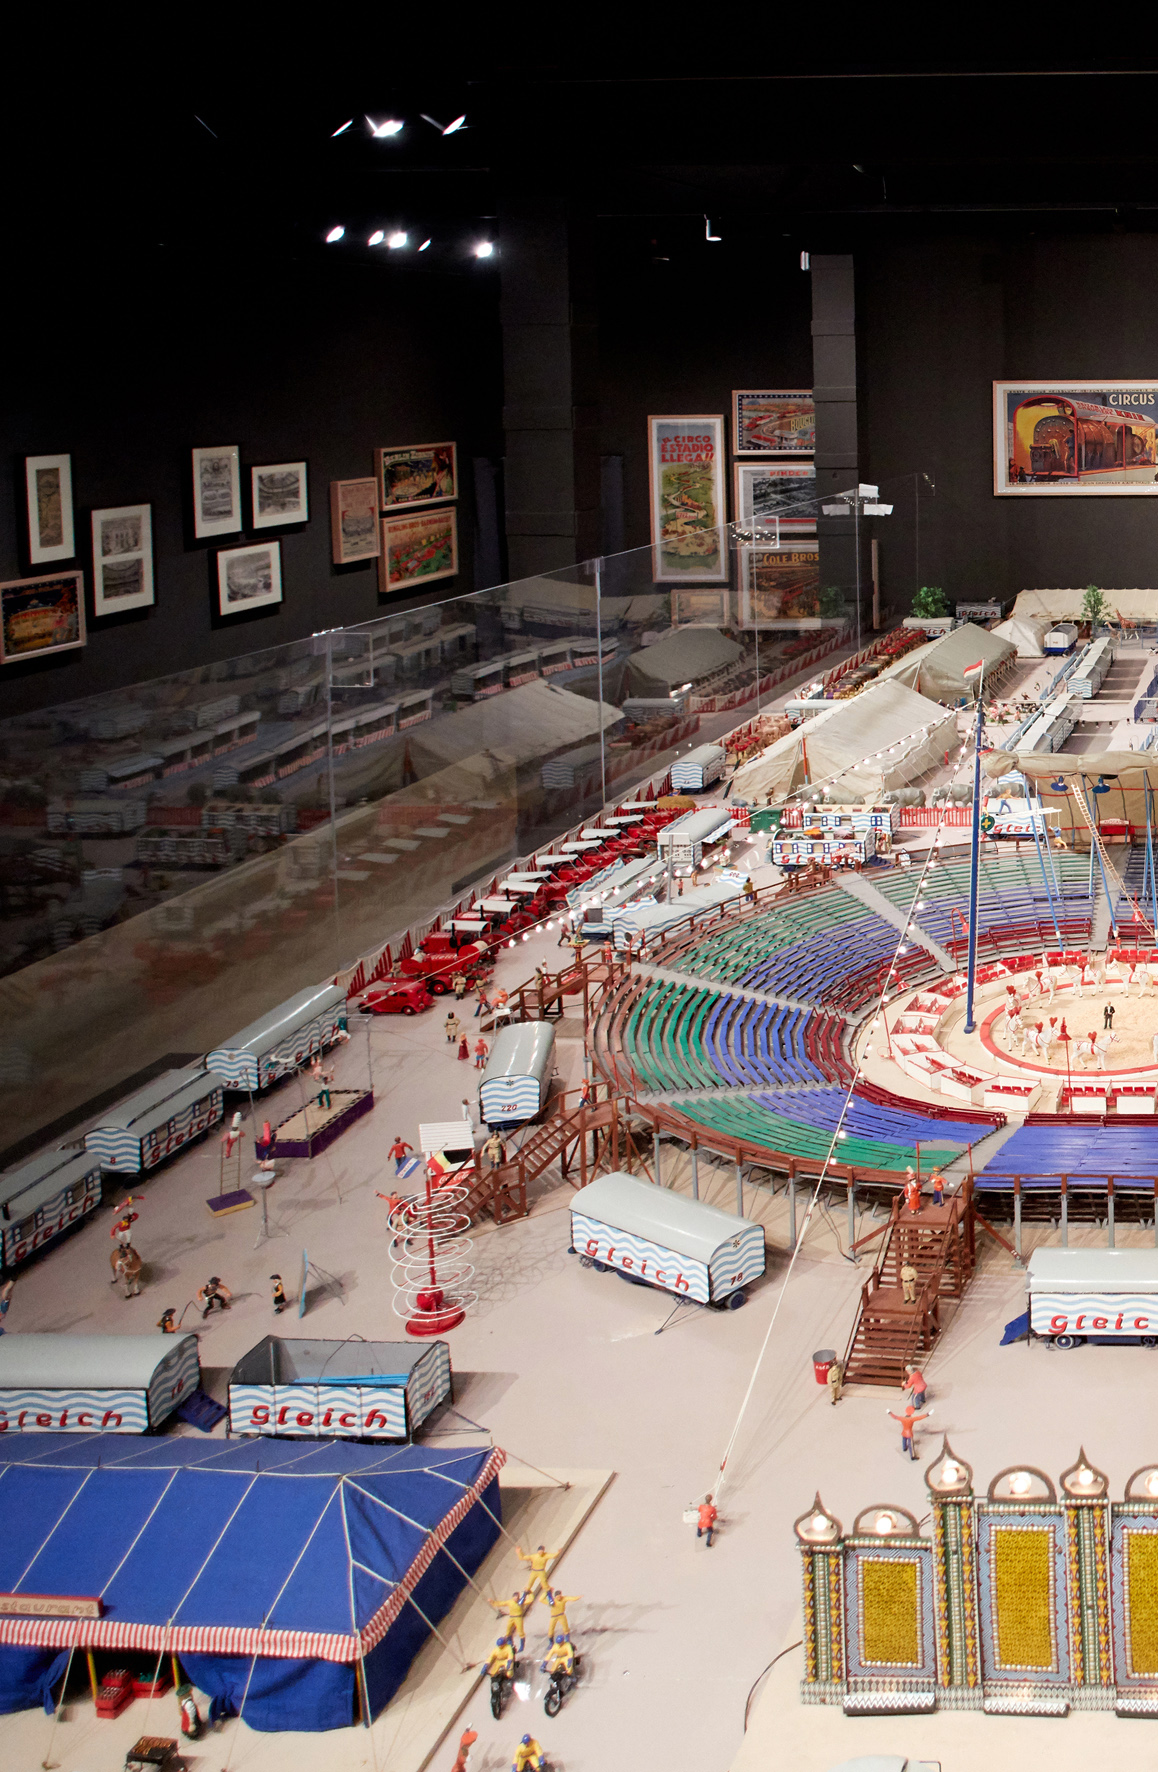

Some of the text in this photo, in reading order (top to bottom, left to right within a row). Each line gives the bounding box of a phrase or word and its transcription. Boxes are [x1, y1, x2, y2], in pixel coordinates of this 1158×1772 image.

[1108, 394, 1155, 406] CIRCUS
[674, 435, 711, 443] CIRCO
[661, 443, 714, 453] ESTADIO
[661, 452, 714, 463] LLEGA!!
[763, 552, 819, 566] COLE BROS
[501, 1104, 517, 1112] 220
[110, 1156, 116, 1165] 8
[730, 1272, 743, 1286] 78
[171, 1378, 184, 1399] 16
